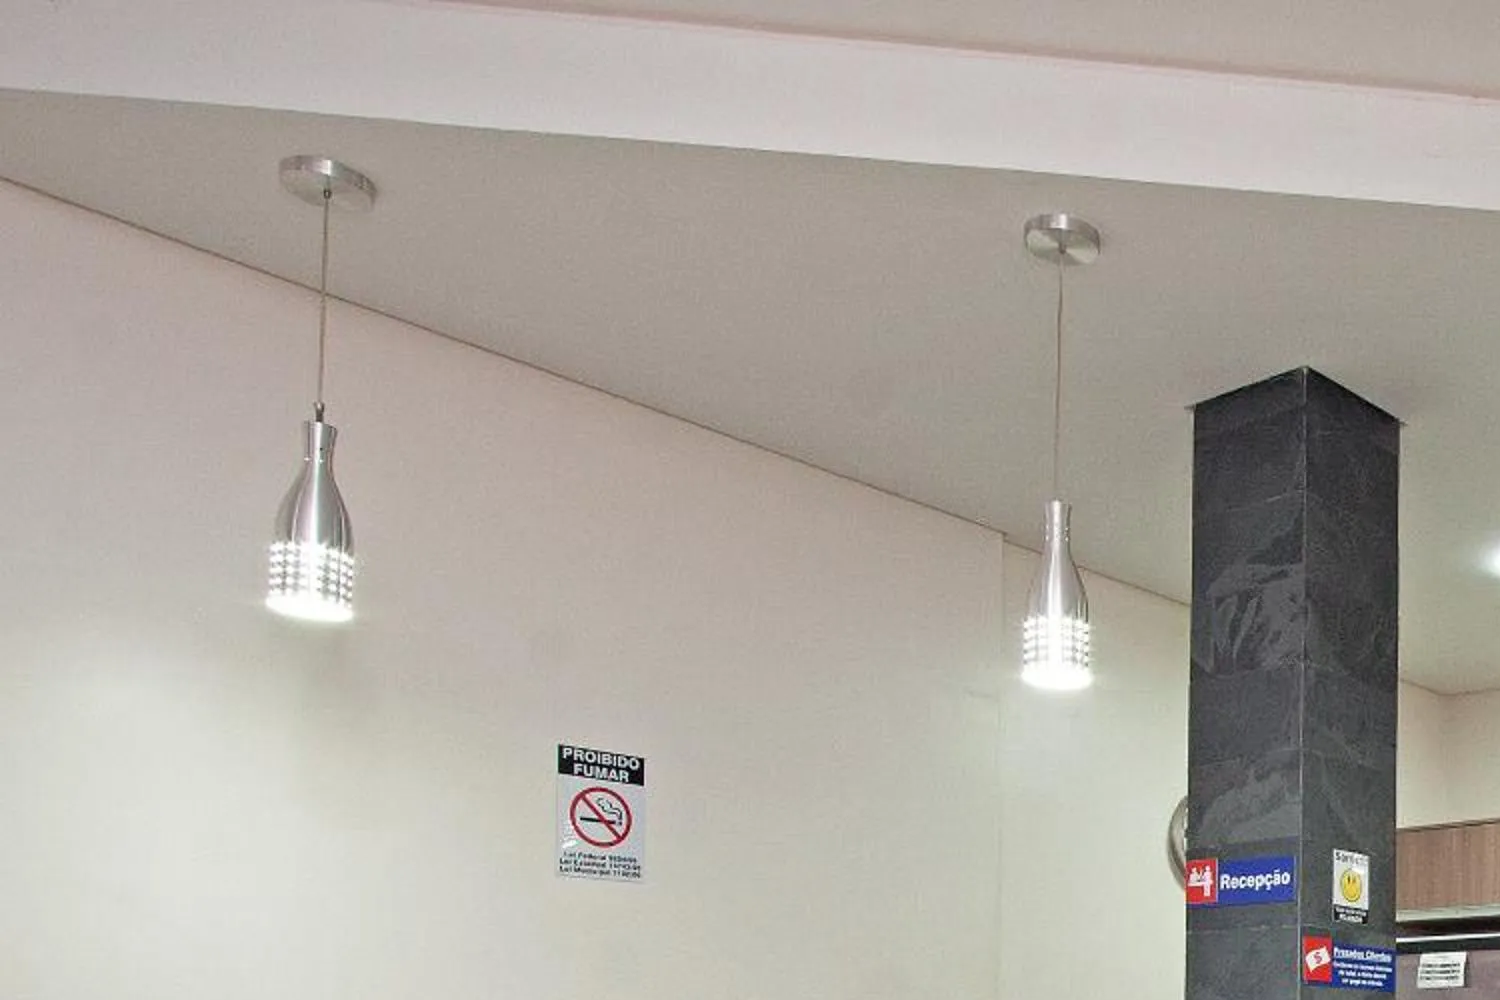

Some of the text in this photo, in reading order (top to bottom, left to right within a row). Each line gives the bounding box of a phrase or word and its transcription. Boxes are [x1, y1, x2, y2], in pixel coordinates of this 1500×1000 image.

[562, 747, 640, 770] PROIBIDO
[573, 763, 630, 783] FUMAR
[1219, 868, 1291, 891] Recepção
